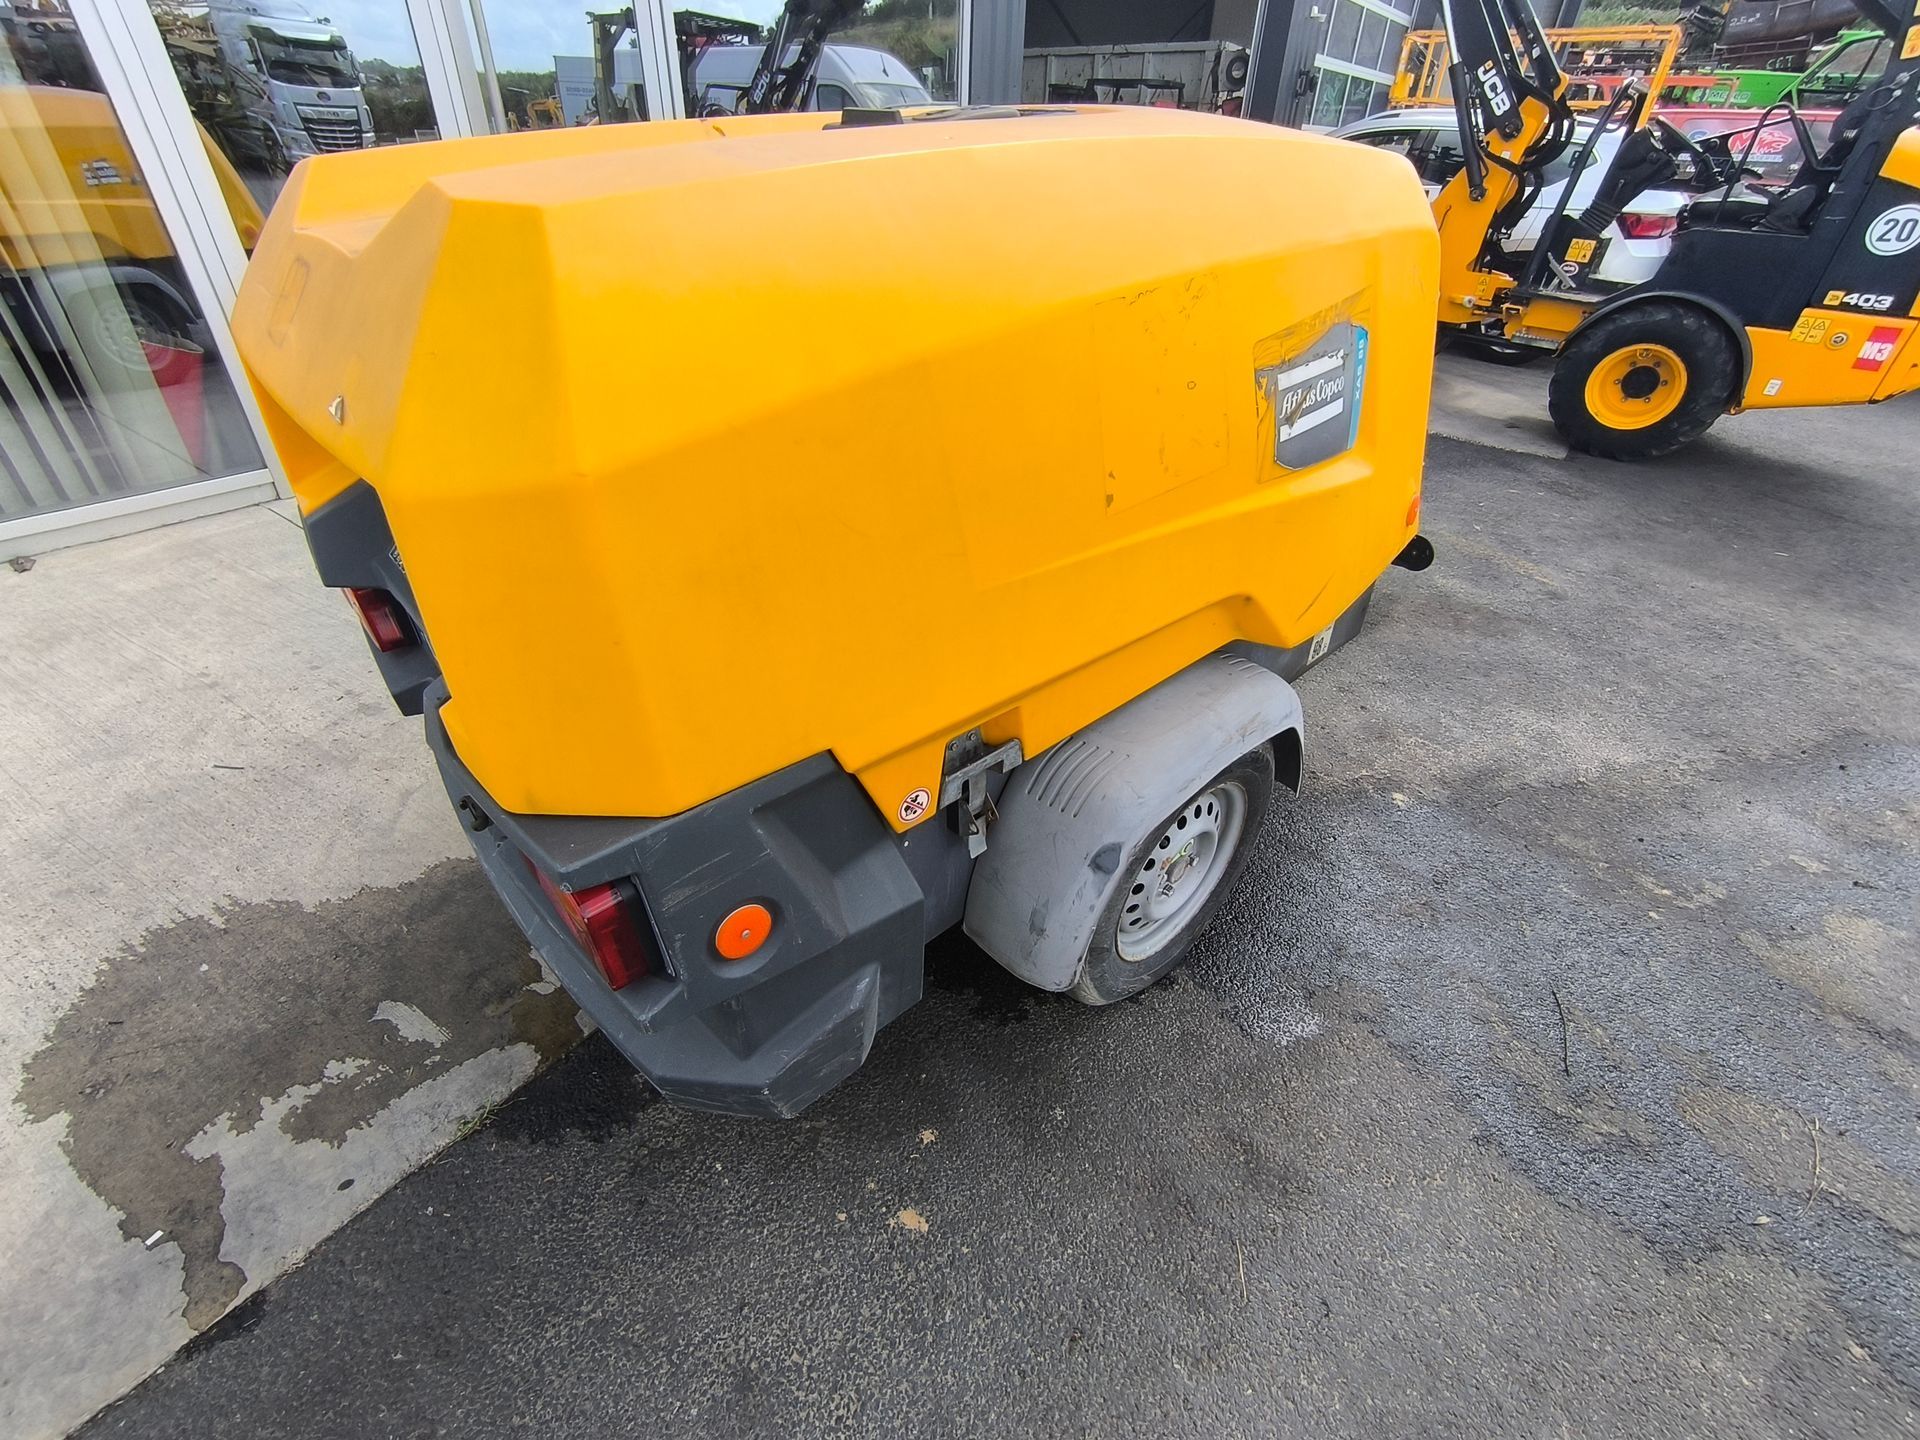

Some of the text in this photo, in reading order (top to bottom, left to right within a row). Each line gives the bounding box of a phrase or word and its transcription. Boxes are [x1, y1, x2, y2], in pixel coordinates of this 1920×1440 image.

[1477, 60, 1511, 116] JCB
[1709, 91, 1751, 104] MELO
[1875, 217, 1920, 243] 20
[1841, 292, 1895, 309] 403
[1857, 341, 1894, 362] M3
[1316, 376, 1345, 402] Copco
